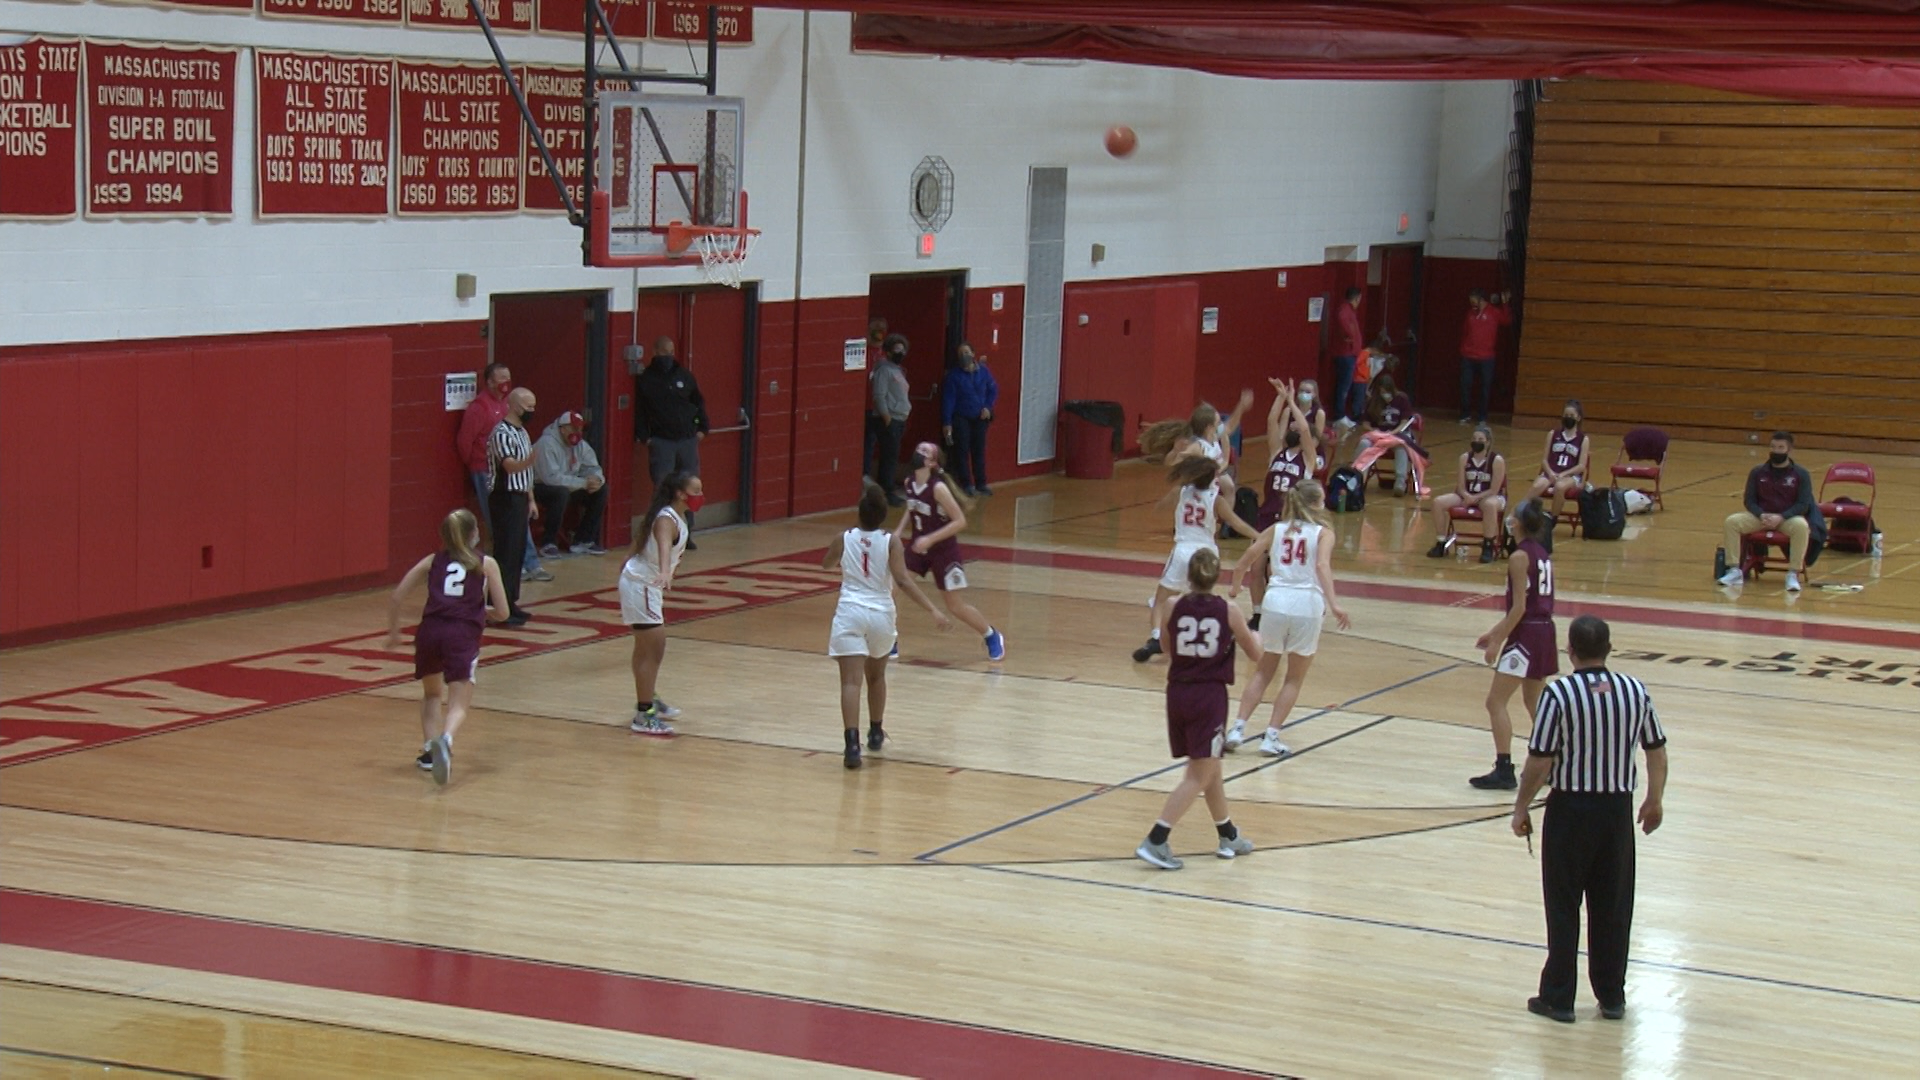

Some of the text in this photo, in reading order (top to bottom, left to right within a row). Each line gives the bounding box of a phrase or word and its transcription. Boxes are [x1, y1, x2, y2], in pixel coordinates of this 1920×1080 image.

[717, 16, 739, 36] 970
[38, 46, 77, 72] STATE
[104, 55, 220, 81] MASSACHUSETTS
[262, 56, 388, 86] MASSACHUSETTS
[98, 85, 144, 107] DIVISION
[285, 83, 367, 110] ALL STATE
[285, 109, 367, 136] CHAMPIONS
[423, 100, 500, 123] ALL STATE
[109, 116, 216, 142] SUPER BOWL
[423, 128, 499, 150] CHAMPIONS
[107, 149, 219, 174] CHAMPIONS
[267, 135, 383, 162] BOYS SPRING TRACK
[299, 161, 324, 183] 1993
[329, 163, 355, 185] 1995
[360, 165, 386, 187] 2002
[438, 157, 469, 177] CROSS
[93, 182, 183, 204] 1993 1994
[403, 184, 436, 205] 1960
[445, 185, 478, 205] 1962
[1272, 475, 1291, 492] 22
[1183, 503, 1207, 529] 22
[861, 551, 871, 578] 1
[1281, 537, 1307, 566] 34
[443, 560, 466, 597] 2
[1175, 615, 1221, 659] 23
